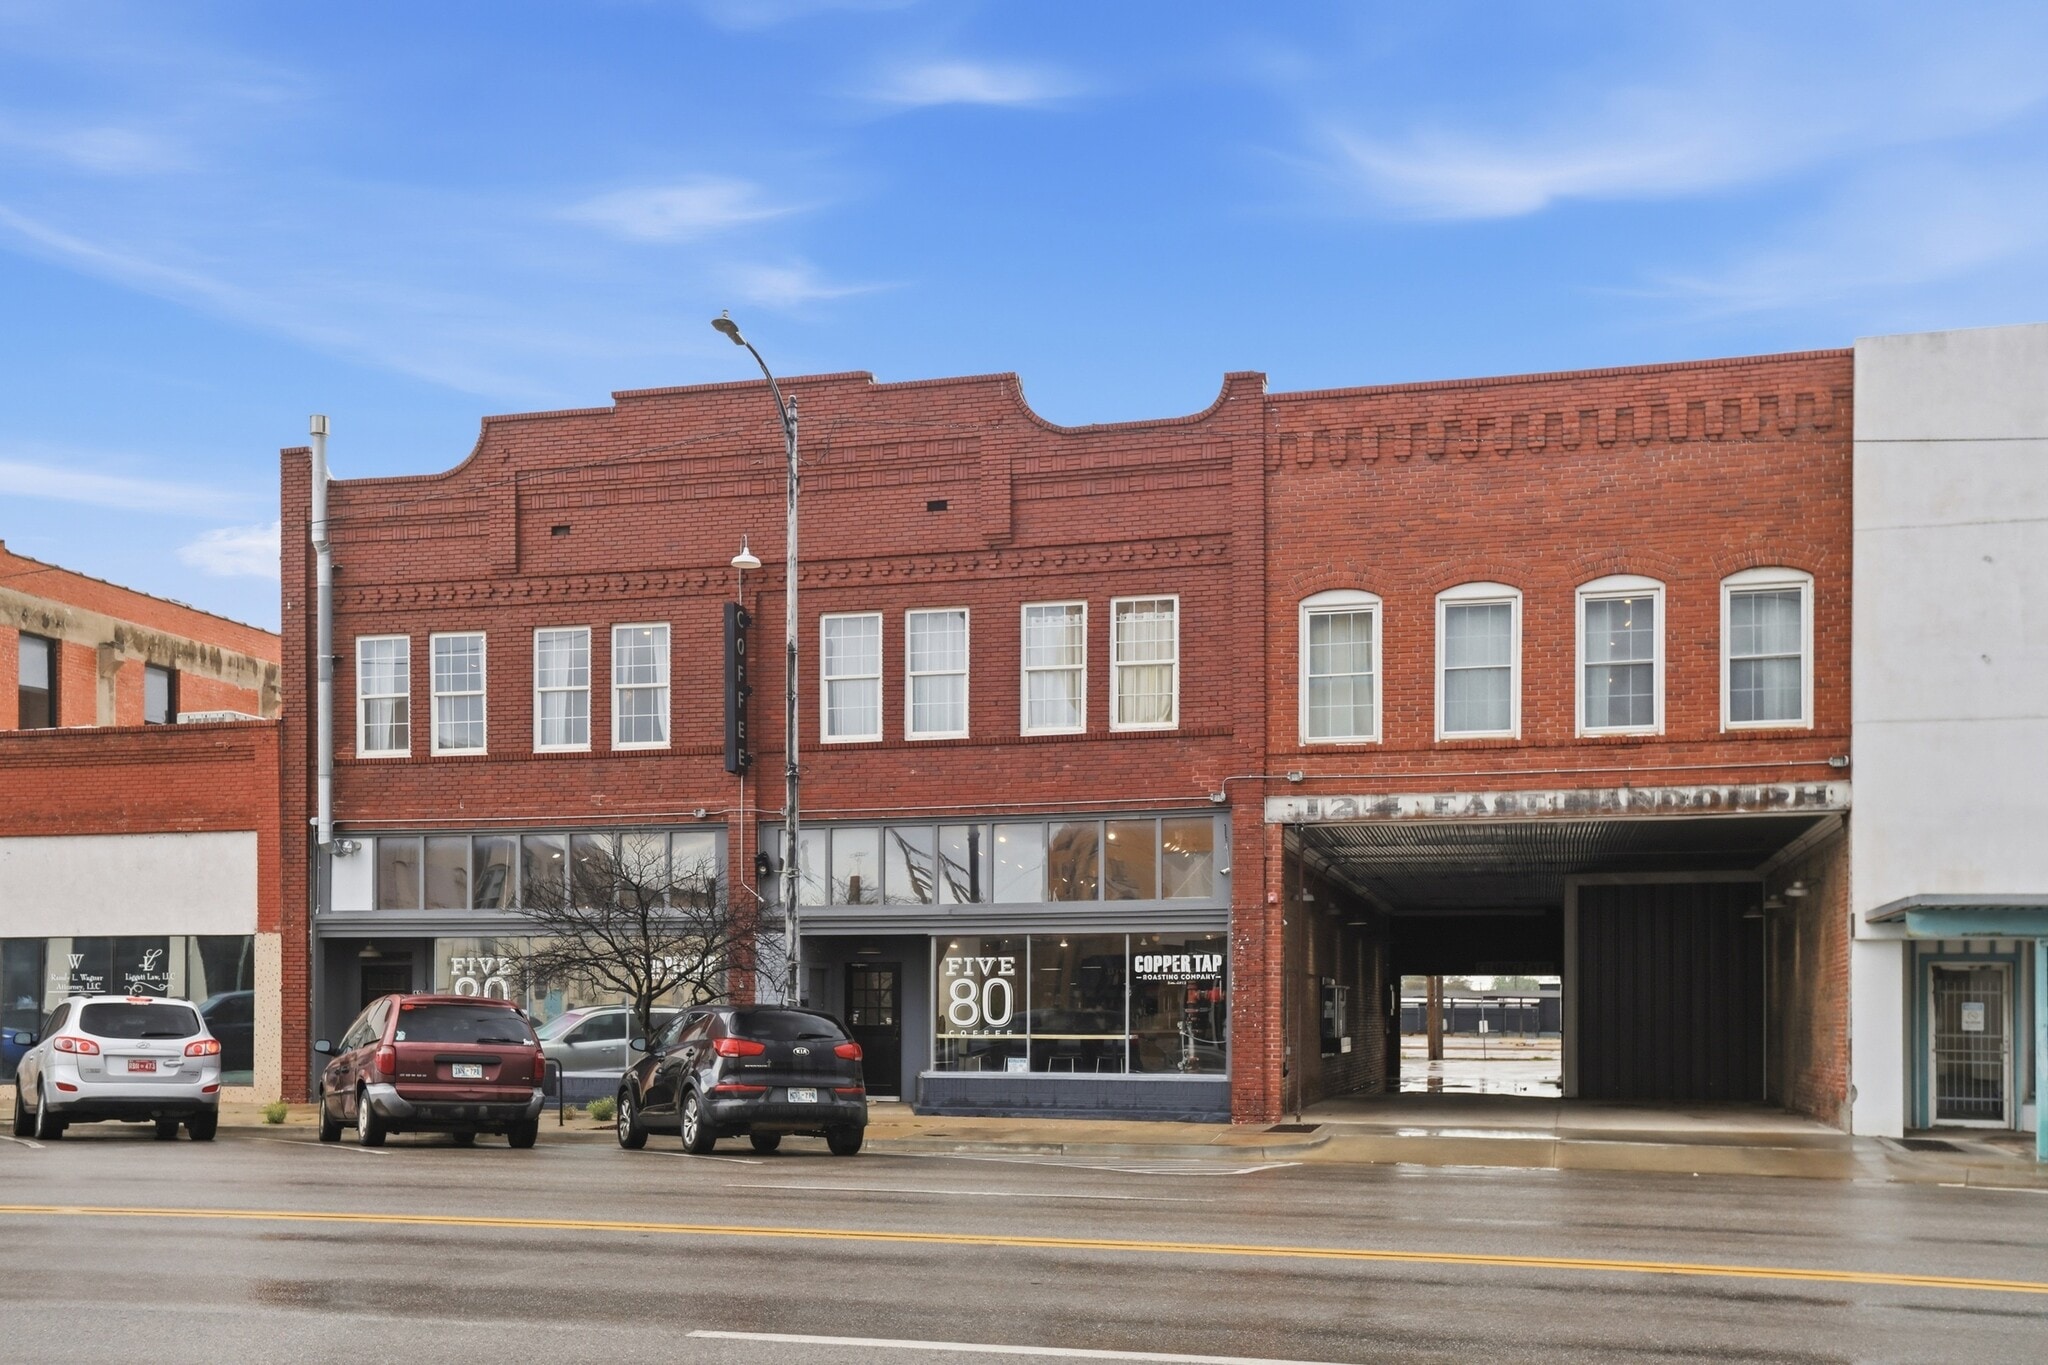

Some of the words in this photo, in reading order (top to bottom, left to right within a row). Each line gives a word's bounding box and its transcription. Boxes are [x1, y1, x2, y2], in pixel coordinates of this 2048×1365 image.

[736, 610, 745, 766] COFFEE
[1306, 797, 1402, 817] 124
[67, 954, 84, 970] W
[451, 957, 512, 976] FIVE
[945, 957, 1016, 976] FIVE
[1134, 955, 1191, 973] COPPER
[1192, 954, 1222, 973] TAP
[86, 982, 101, 990] LLC
[1180, 973, 1215, 981] COMPANY
[948, 978, 1013, 1028] 80
